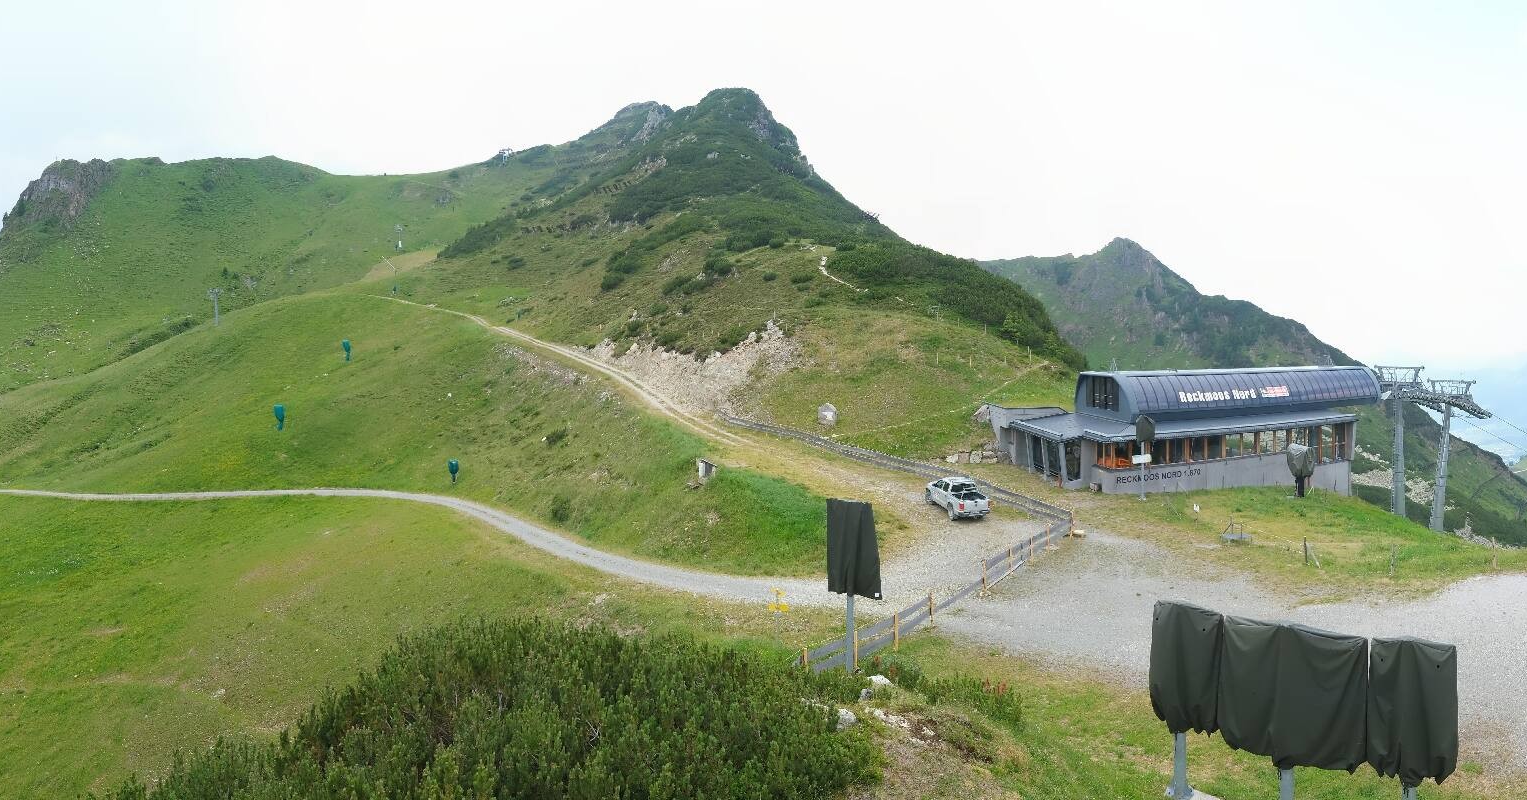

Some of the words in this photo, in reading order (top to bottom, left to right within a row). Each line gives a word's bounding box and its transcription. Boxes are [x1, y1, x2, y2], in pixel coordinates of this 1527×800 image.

[1178, 390, 1230, 402] Reckmoos
[1232, 388, 1257, 400] Nord
[1161, 470, 1182, 480] NORD
[1183, 468, 1201, 477] 1.870
